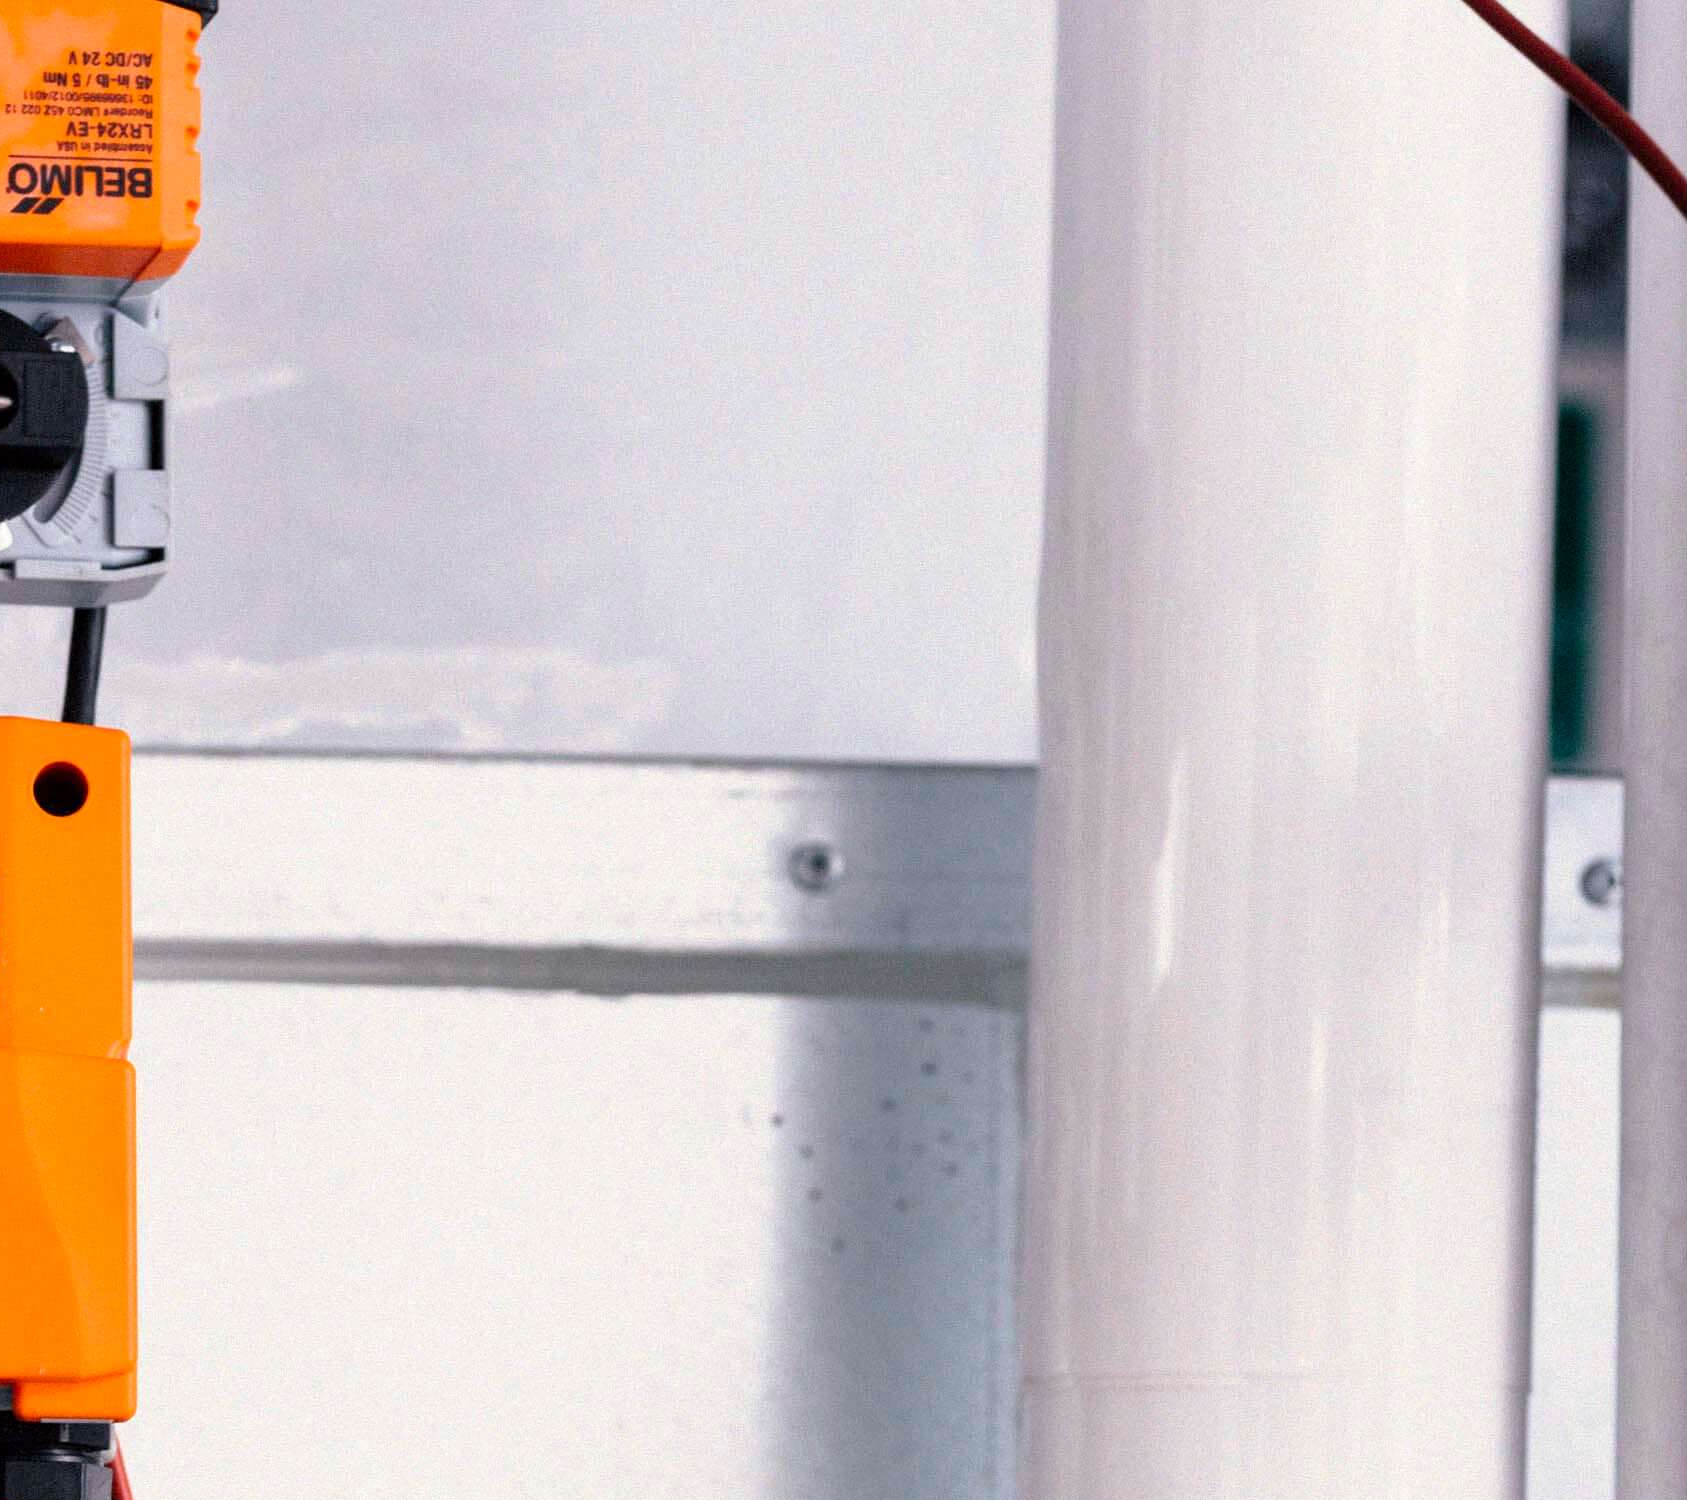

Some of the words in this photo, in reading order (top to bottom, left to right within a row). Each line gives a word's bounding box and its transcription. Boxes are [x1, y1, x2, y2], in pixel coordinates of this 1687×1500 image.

[69, 51, 77, 64] V
[82, 52, 100, 65] 24
[106, 52, 153, 67] AC/DC
[43, 72, 67, 86] Nm
[73, 73, 81, 87] 5
[86, 73, 92, 87] /
[97, 74, 129, 88] in-lb
[136, 75, 153, 88] 45
[140, 92, 153, 103] ID:
[5, 104, 17, 115] 12
[21, 104, 40, 115] 022
[104, 105, 153, 118] Reorder#
[66, 121, 153, 138] LRX24-EV
[57, 141, 77, 152] USA
[93, 142, 153, 154] Assembled
[7, 162, 153, 199] BELIMO
